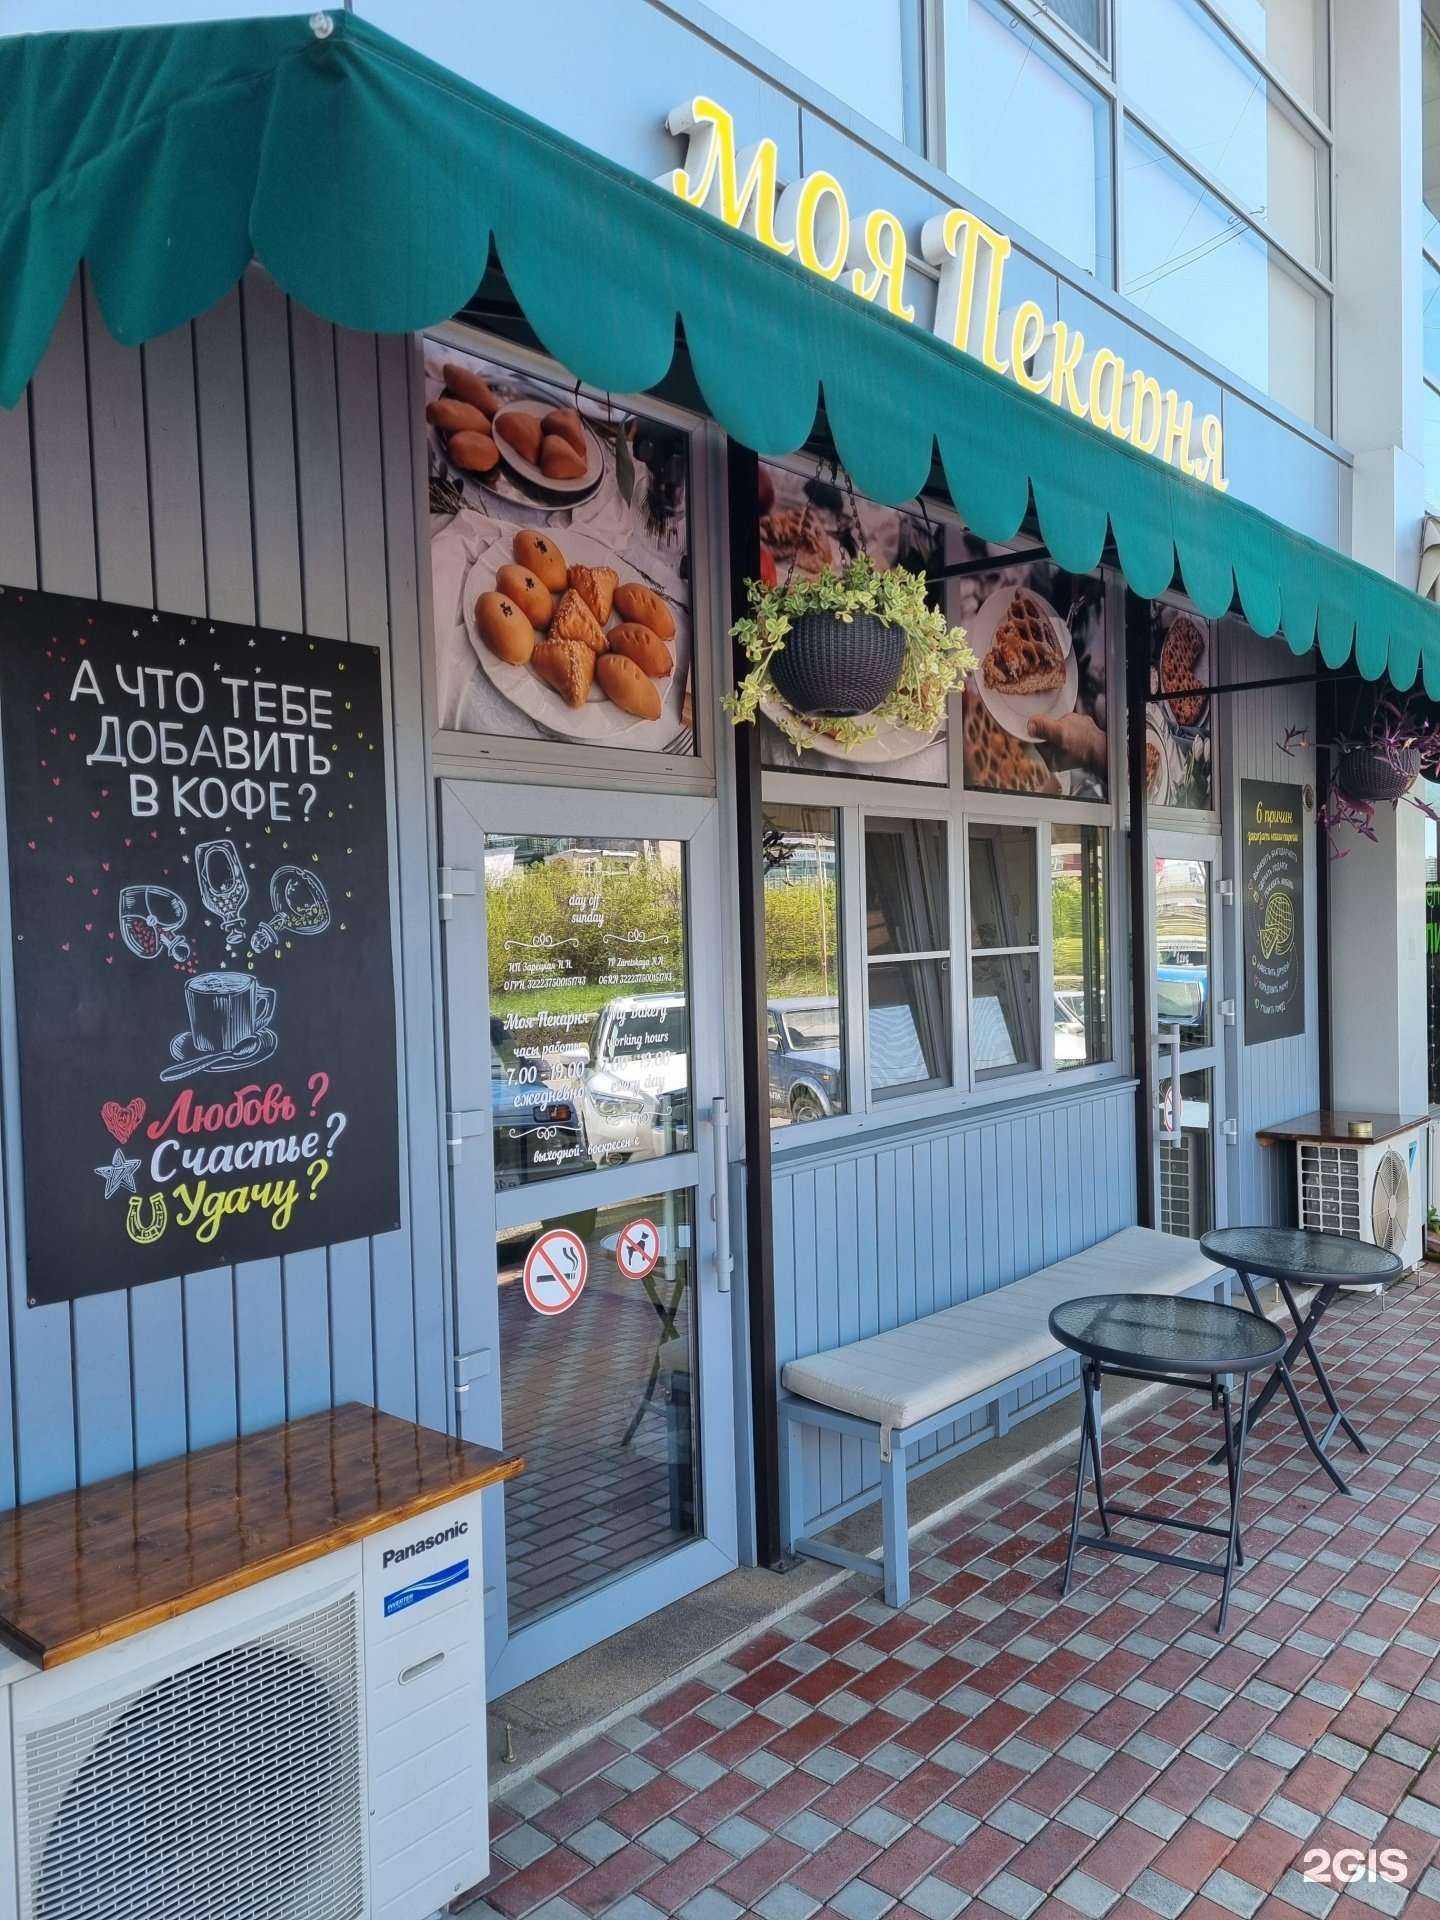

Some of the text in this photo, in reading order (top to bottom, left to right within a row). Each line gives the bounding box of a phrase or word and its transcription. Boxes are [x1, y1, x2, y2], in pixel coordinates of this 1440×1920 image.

[671, 95, 1230, 493] Моя Пекарня
[70, 658, 333, 730] А ЧТО ТЕБЕ
[86, 715, 331, 776] ДОБАВИТЬ
[130, 773, 159, 817] В
[1256, 800, 1293, 830] 6 причин
[568, 894, 601, 911] day off
[571, 912, 605, 927] sunday
[503, 1011, 590, 1033] Моя Пекарня
[513, 1045, 540, 1058] часы
[607, 1032, 669, 1051] working hours
[507, 1066, 537, 1086] 7.00
[550, 1061, 585, 1081] 19.00
[147, 1083, 296, 1140] Любовь
[513, 1085, 585, 1112] ежедневно
[587, 1136, 640, 1160] воскресене
[382, 1521, 469, 1568] Panasonic
